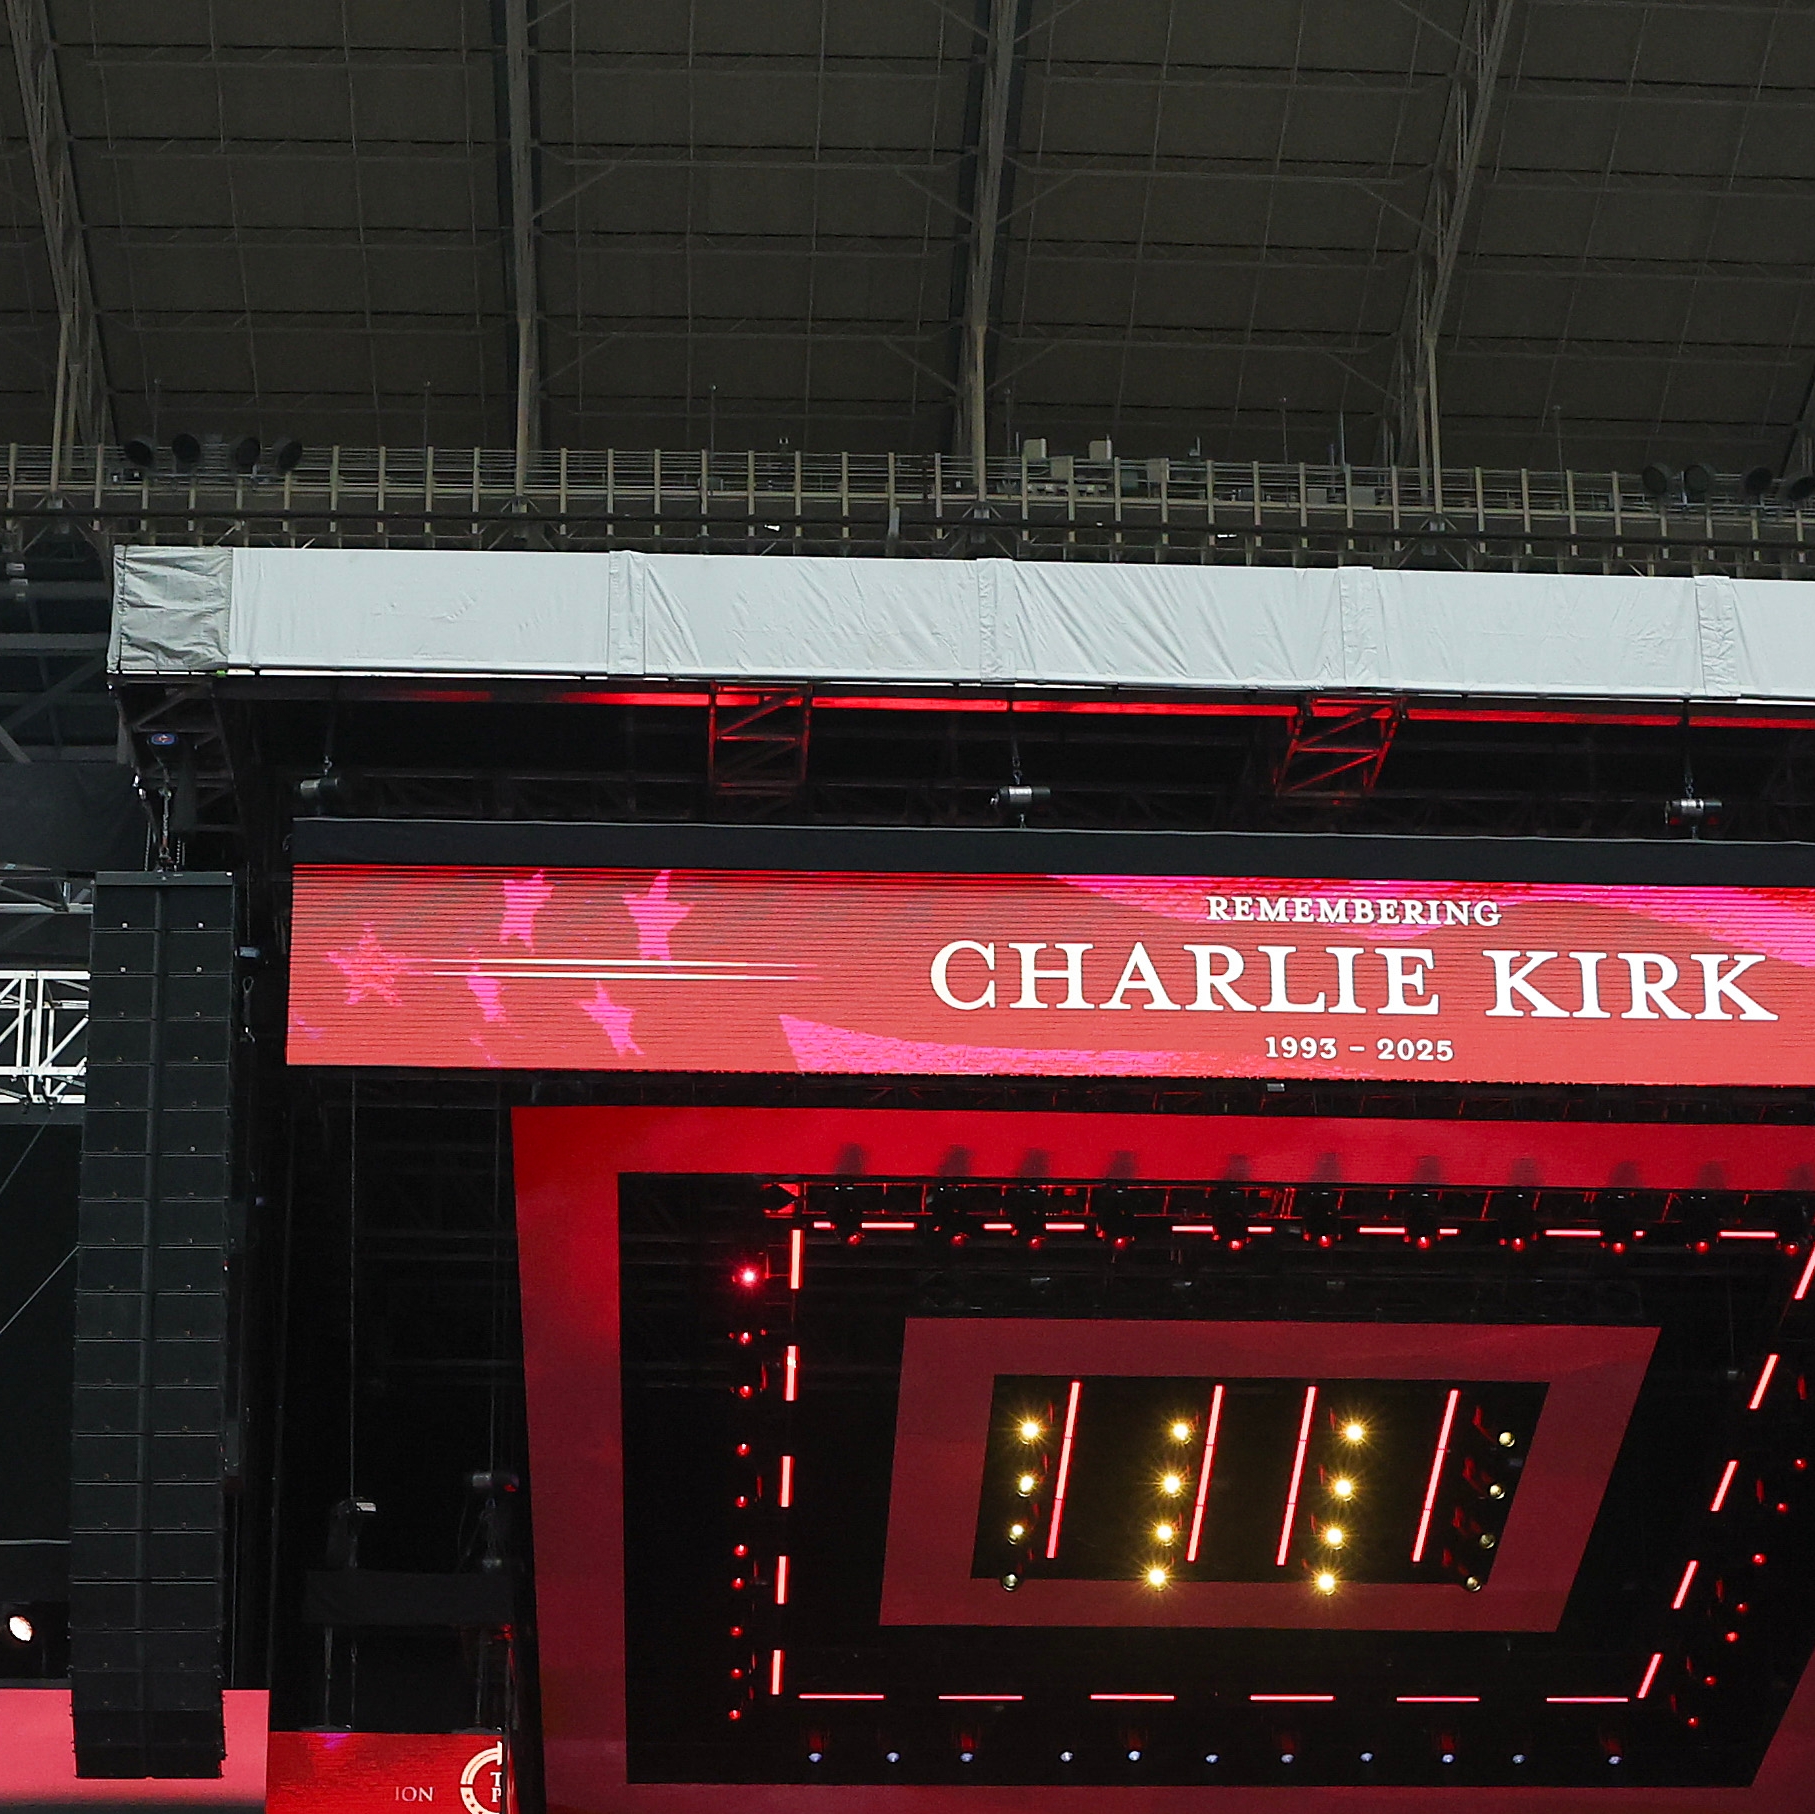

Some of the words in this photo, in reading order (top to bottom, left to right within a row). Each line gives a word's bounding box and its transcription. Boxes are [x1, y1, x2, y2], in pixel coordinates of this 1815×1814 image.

[1206, 895, 1502, 928] REMEMBERING
[929, 938, 1440, 1015] CHARLIE
[1482, 949, 1780, 1021] KIRK
[1265, 1036, 1337, 1060] 1993
[1376, 1038, 1454, 1062] 2025
